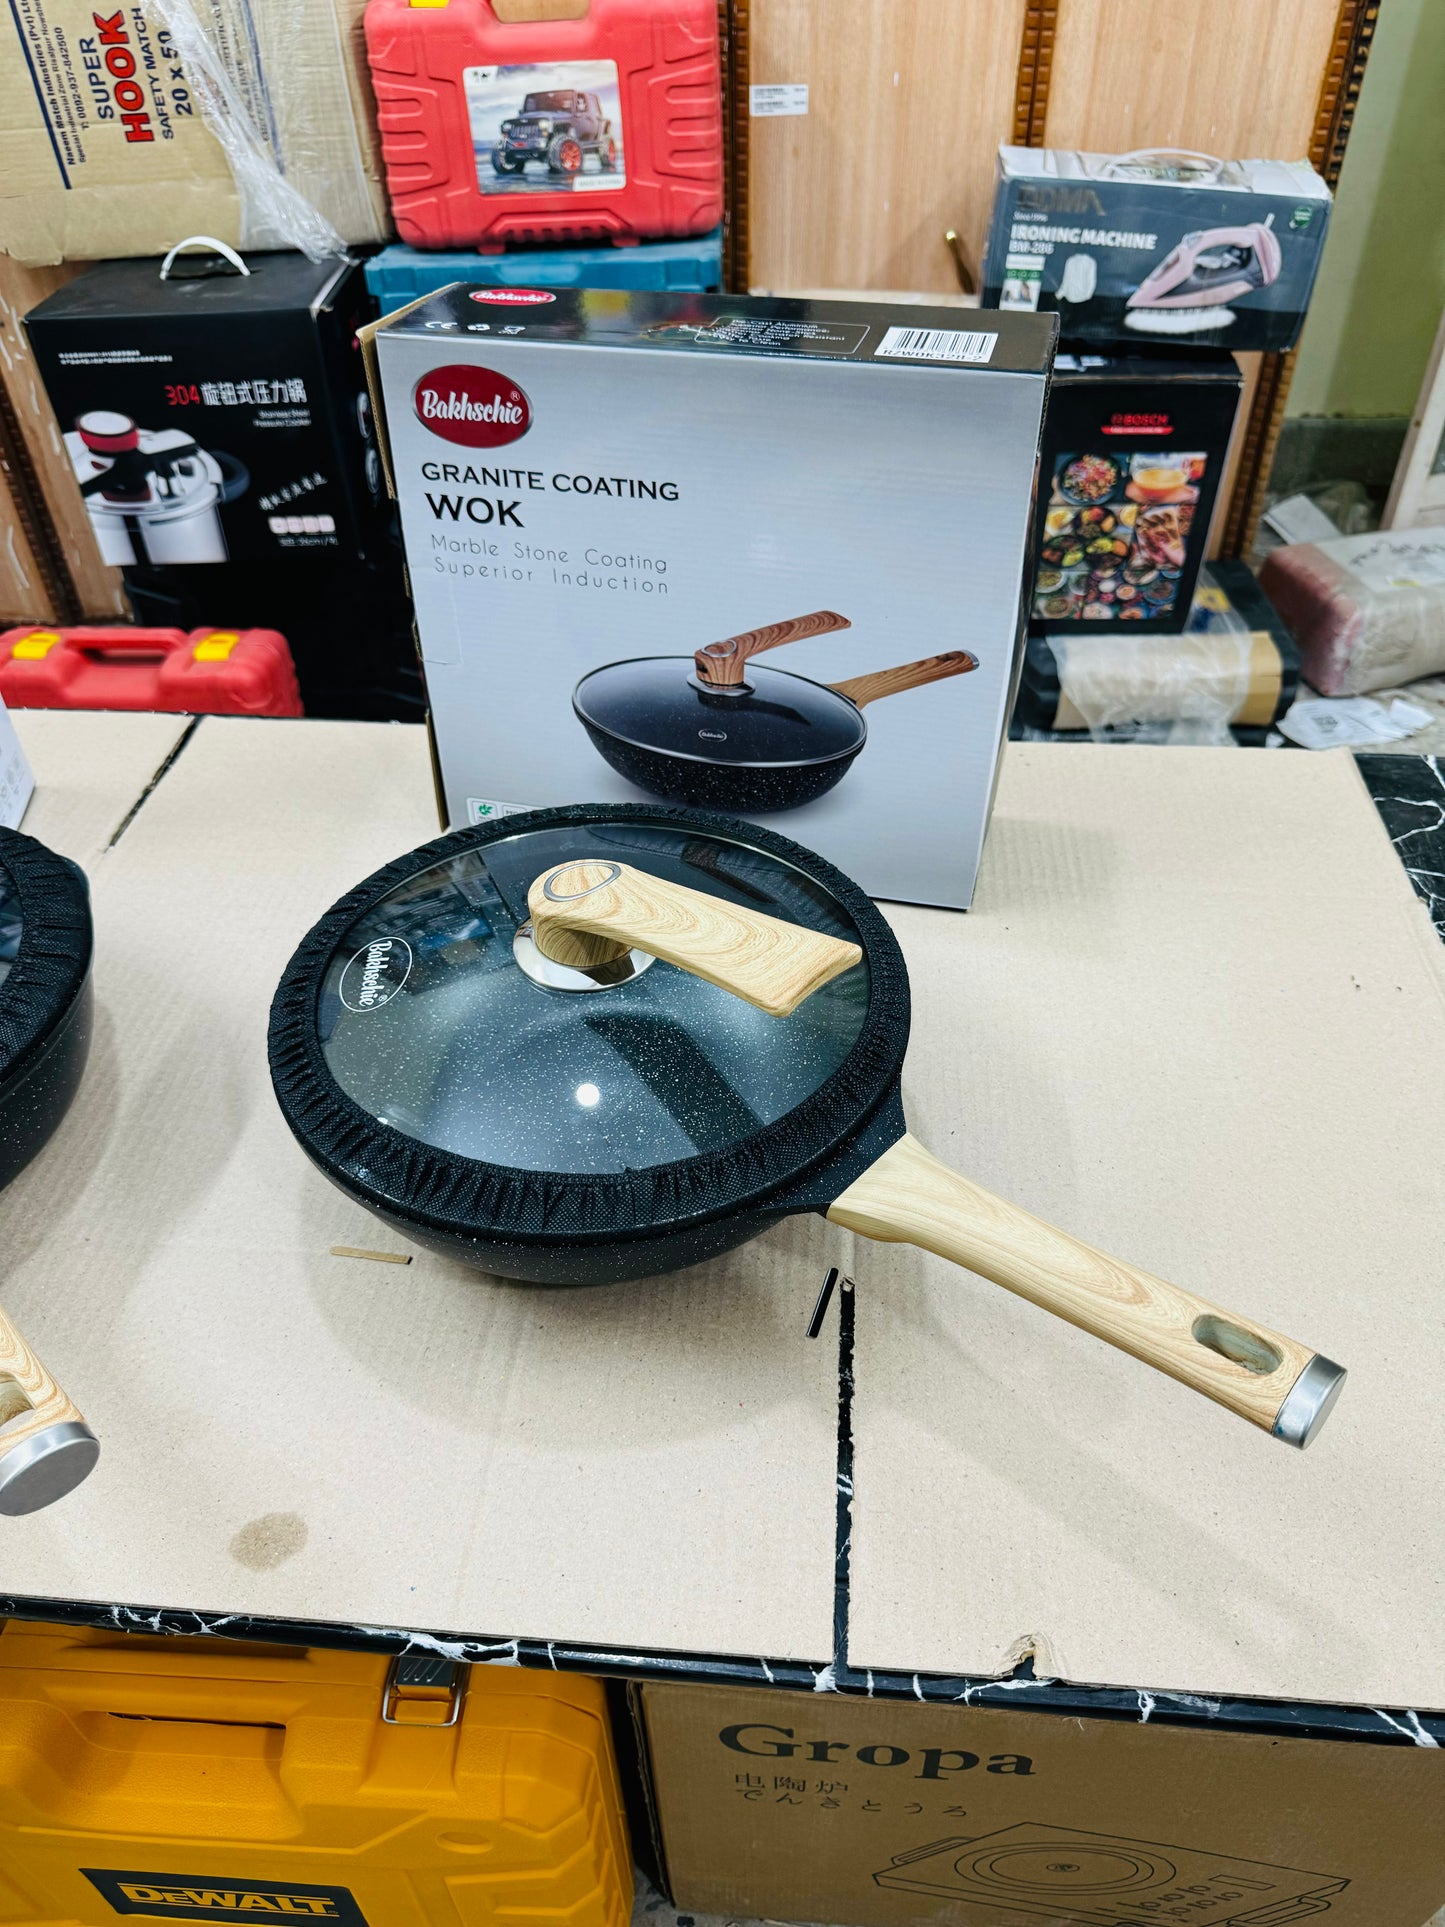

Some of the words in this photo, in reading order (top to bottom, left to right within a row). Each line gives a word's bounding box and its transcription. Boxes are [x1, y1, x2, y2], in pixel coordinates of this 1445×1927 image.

[25, 16, 40, 41] (Pvt)
[131, 7, 156, 70] MATCH
[157, 30, 178, 59] 50
[35, 44, 55, 96] Industries
[79, 37, 114, 119] SUPER
[92, 9, 155, 143] HOOK
[50, 98, 65, 129] Match
[147, 73, 174, 140] SAFETY
[171, 88, 193, 116] 20
[72, 134, 86, 163] Special
[1010, 224, 1082, 243] IRONING
[1081, 228, 1158, 250] MACHINE
[421, 389, 523, 425] Bakhschie
[421, 462, 545, 491] GRANITE
[552, 474, 680, 501] COATING
[424, 493, 526, 528] WOK
[431, 534, 499, 558] Marble
[514, 542, 569, 564] Stone
[585, 548, 668, 574] Coating
[435, 556, 534, 582] Superior
[552, 568, 669, 594] Induction
[358, 940, 393, 1007] Bakhschie
[718, 1722, 1037, 1781] Gropa
